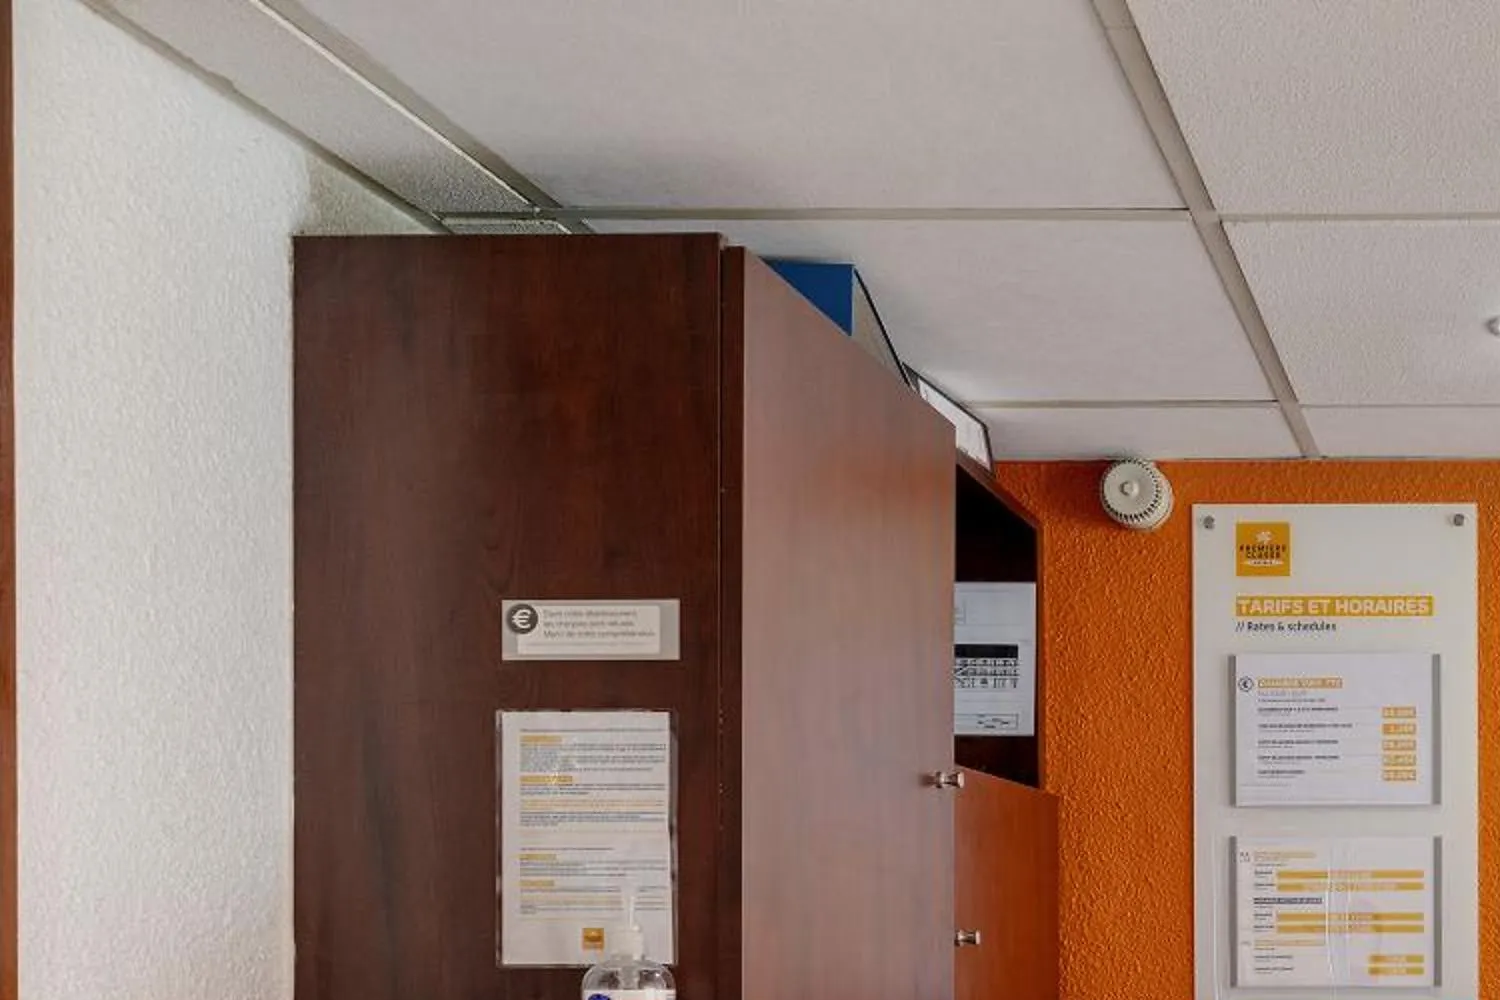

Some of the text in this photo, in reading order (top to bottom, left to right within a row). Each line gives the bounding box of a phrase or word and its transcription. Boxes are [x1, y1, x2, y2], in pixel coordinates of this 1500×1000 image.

[1238, 599, 1429, 614] TARIFS ET HORAIRES
[1247, 621, 1275, 631] Rates
[1278, 621, 1285, 631] &
[1287, 621, 1337, 631] schedules
